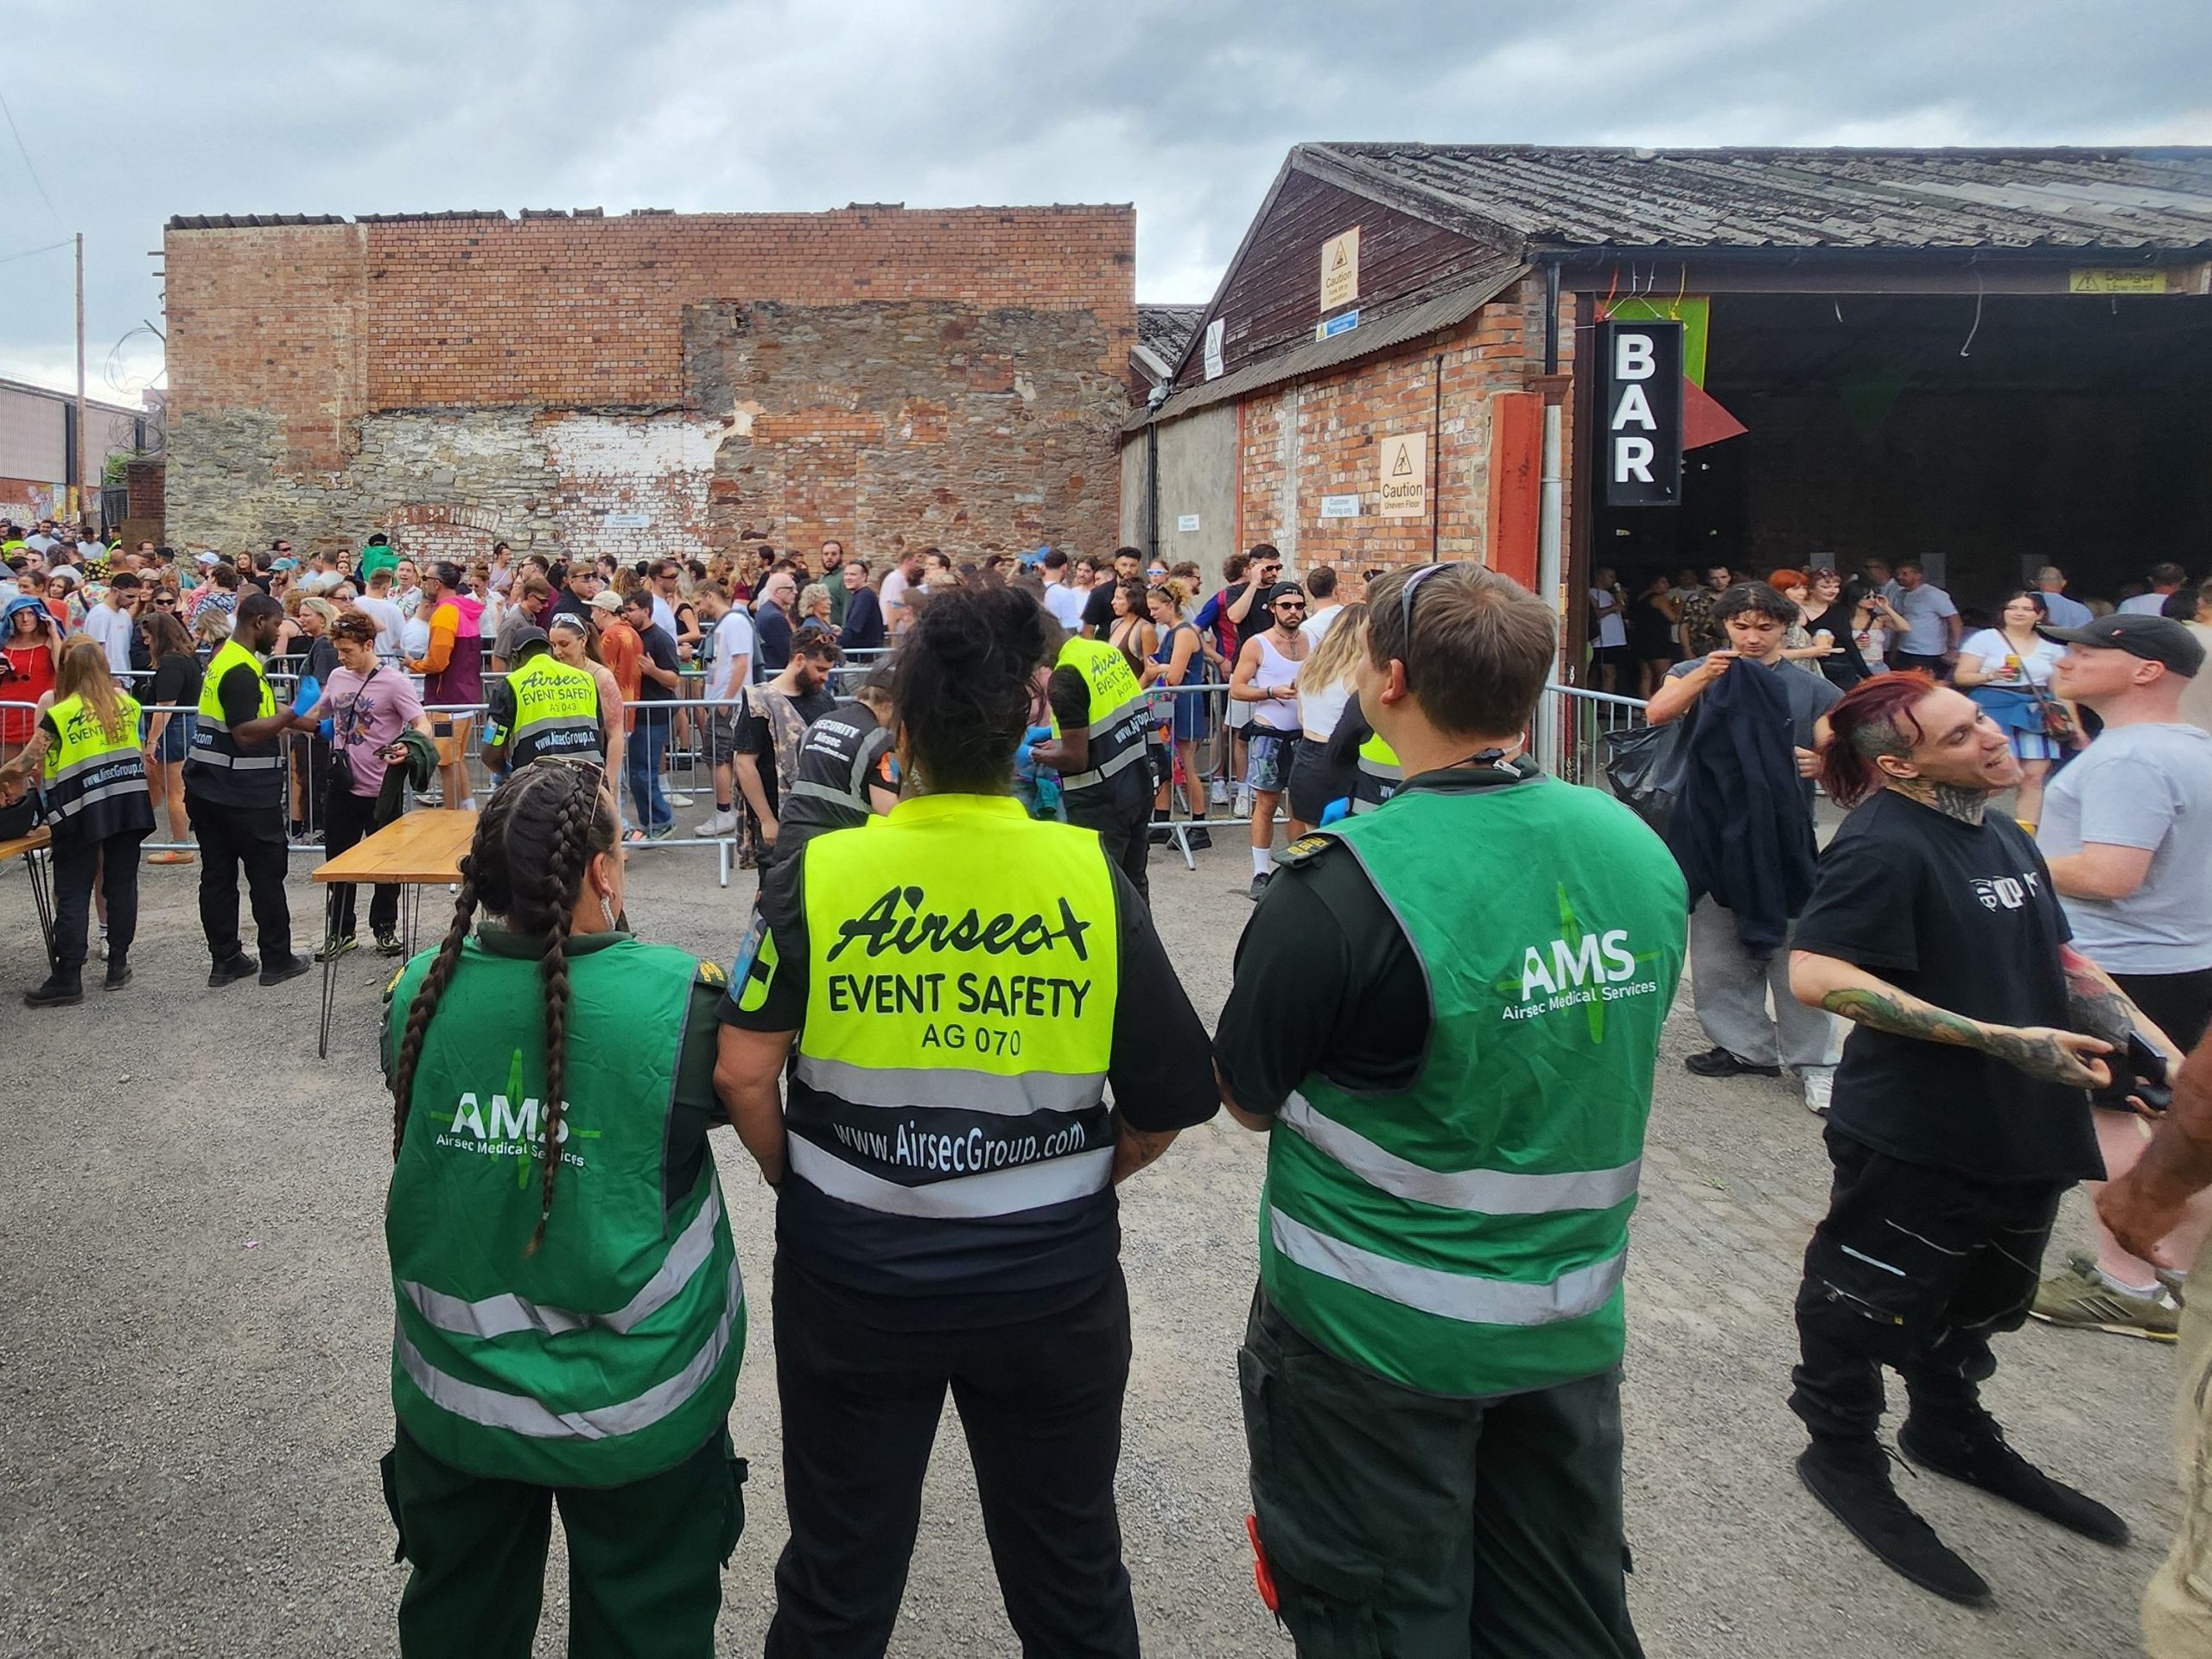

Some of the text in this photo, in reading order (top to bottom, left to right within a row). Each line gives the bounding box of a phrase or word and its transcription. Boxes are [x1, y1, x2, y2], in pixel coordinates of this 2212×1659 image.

[1325, 270, 1352, 289] Caution
[2106, 270, 2155, 283] Danger
[1611, 334, 1657, 482] BAR
[1382, 481, 1423, 499] Caution
[1384, 499, 1421, 510] Uneven Floor
[522, 688, 593, 706] EVENT SAFETY
[67, 724, 104, 744] EVENT
[813, 719, 861, 739] SECURITY
[1522, 929, 1636, 1001] AMS
[829, 972, 1091, 1019] EVENT SAFETY
[1502, 981, 1656, 1020] Airsec Medical Services
[921, 1023, 1021, 1057] AG 070
[435, 1134, 584, 1167] Airsec Medical Seices
[833, 1120, 1086, 1173] www.AirsecGroup.com
